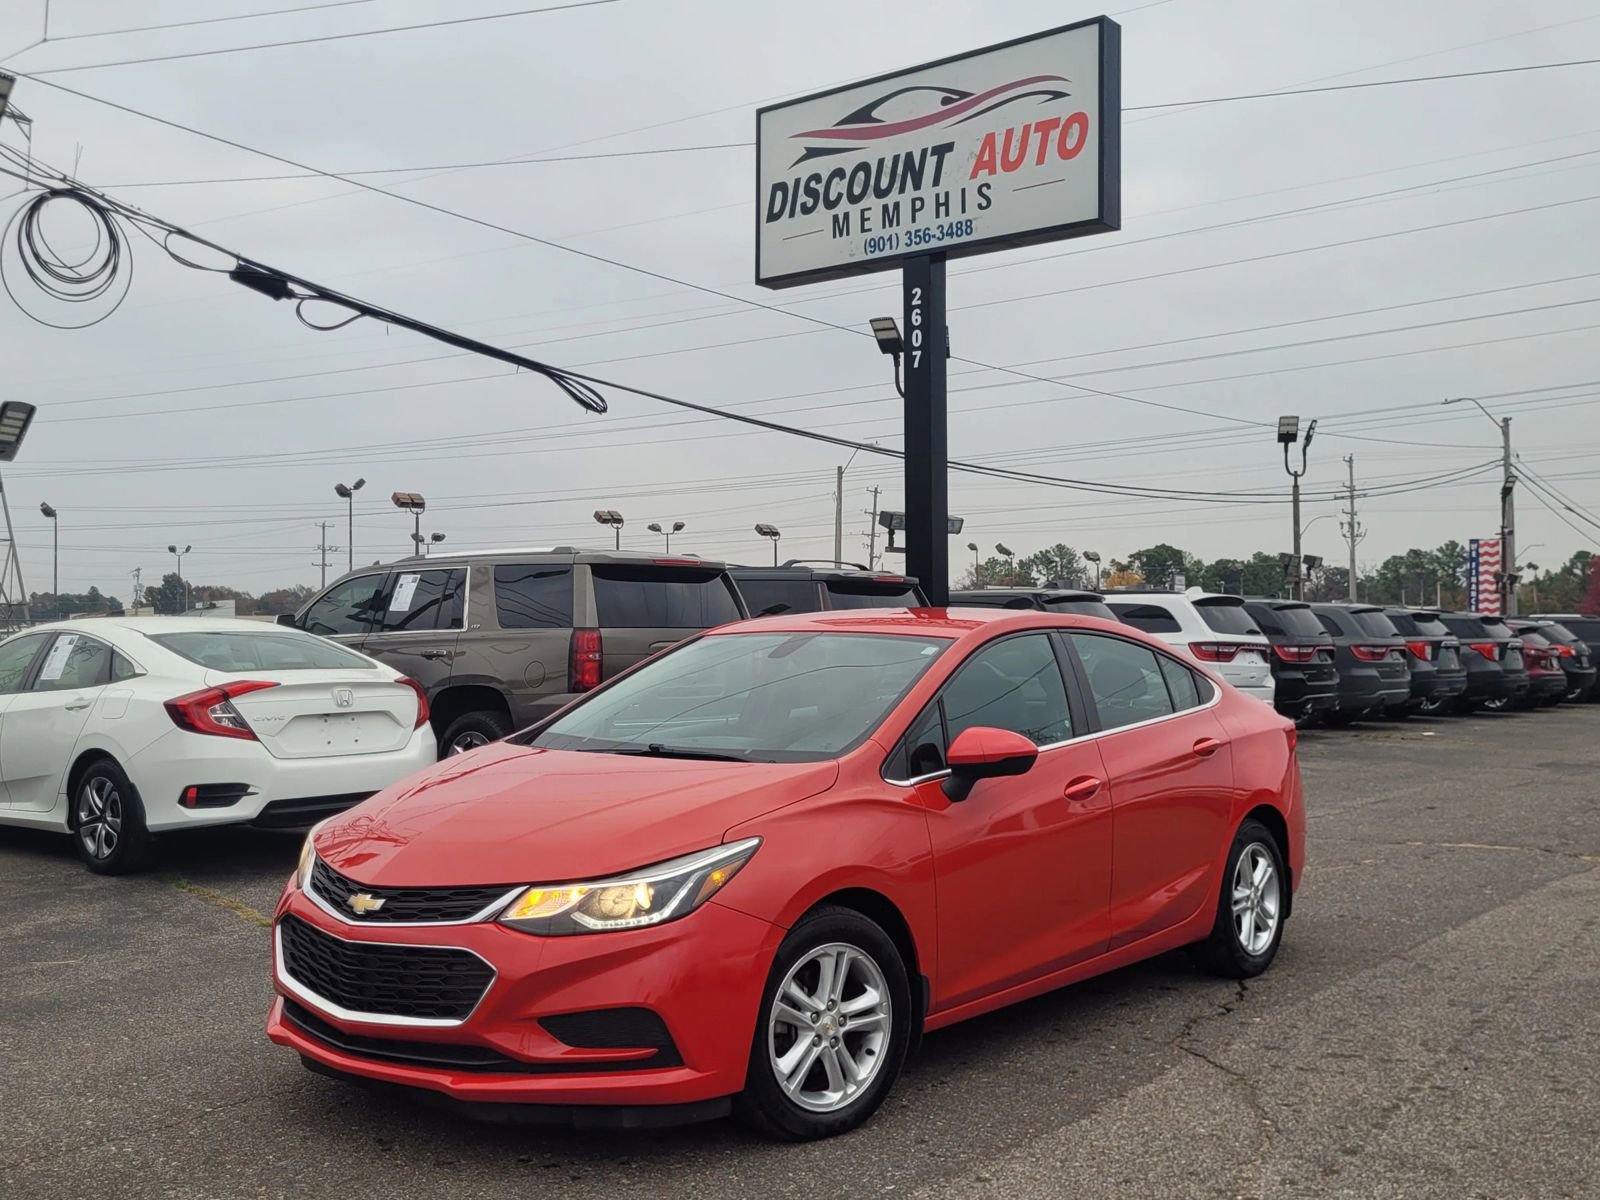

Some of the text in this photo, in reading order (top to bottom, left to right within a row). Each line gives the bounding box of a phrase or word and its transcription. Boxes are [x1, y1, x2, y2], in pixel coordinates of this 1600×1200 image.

[765, 111, 1089, 224] DISCOUNT AUTO
[831, 182, 993, 240] MEMPHIS
[863, 219, 974, 256] (901) 356-3488
[911, 287, 923, 369] 2607
